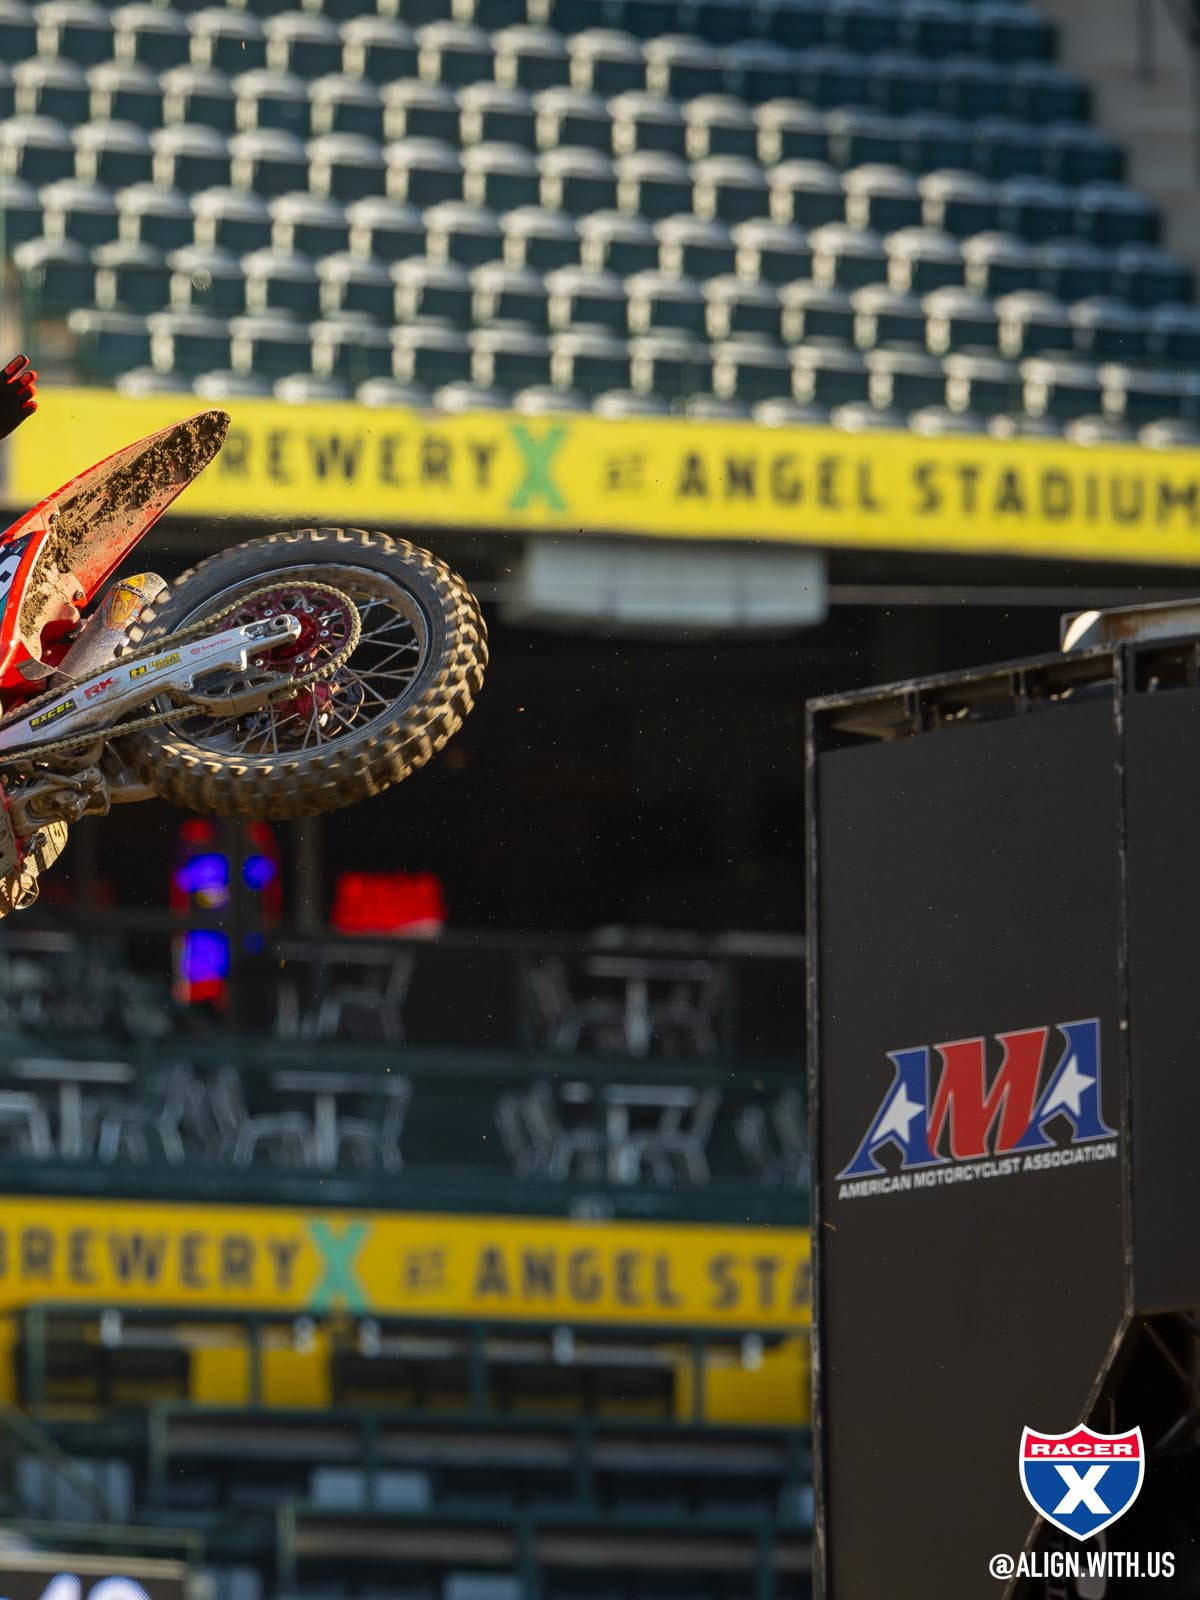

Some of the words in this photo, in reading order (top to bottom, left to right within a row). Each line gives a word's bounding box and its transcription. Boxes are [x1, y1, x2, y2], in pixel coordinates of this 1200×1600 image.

[677, 451, 883, 513] ANGEL
[912, 460, 1200, 530] STADIUM
[31, 701, 73, 727] EXCEL
[83, 677, 113, 700] RK
[834, 1018, 1119, 1180] AMA
[838, 1174, 912, 1200] AMERICAN
[913, 1155, 1019, 1189] MOTORCYCLIST
[1022, 1142, 1117, 1171] ASSOCIATION
[477, 1244, 682, 1309] ANGEL
